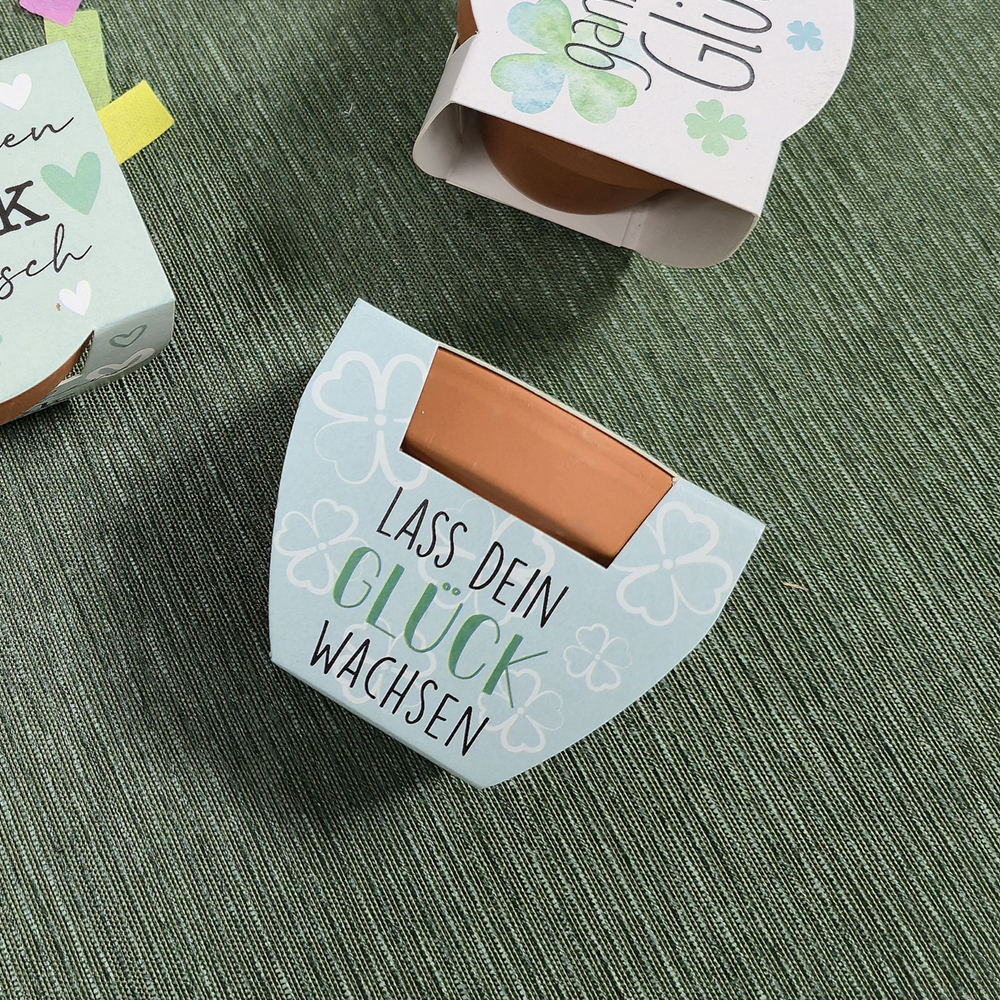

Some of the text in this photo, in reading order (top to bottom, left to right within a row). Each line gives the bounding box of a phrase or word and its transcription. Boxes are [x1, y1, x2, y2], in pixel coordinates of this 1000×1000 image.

[332, 546, 549, 708] GLÜCK
[376, 486, 570, 629] LASS DEIN
[309, 620, 491, 756] WACHSEN
